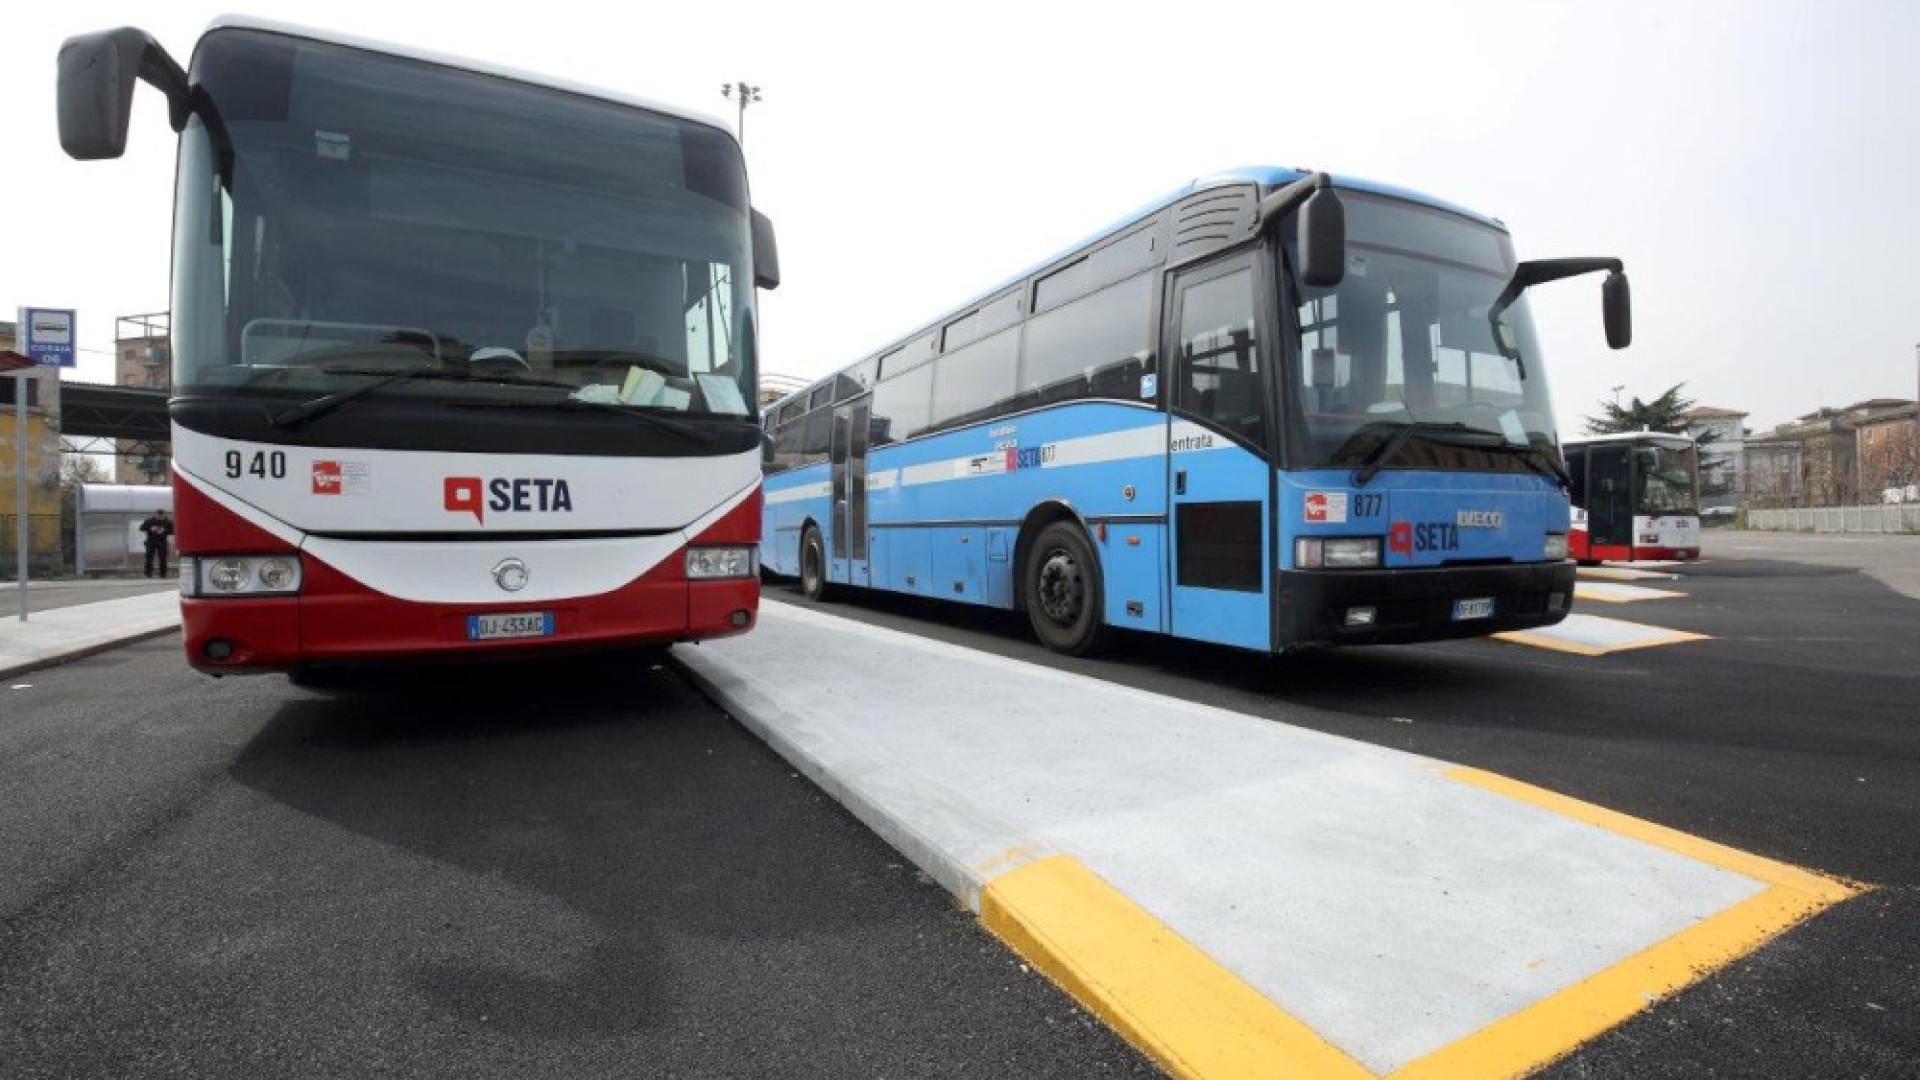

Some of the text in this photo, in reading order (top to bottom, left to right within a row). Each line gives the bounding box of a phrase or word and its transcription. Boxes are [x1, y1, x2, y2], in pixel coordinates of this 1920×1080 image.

[1170, 434, 1212, 452] entrata
[226, 450, 286, 479] 940
[1018, 446, 1041, 469] SETA
[489, 477, 572, 512] SETA
[1355, 493, 1381, 517] 877
[1414, 522, 1459, 551] SETA
